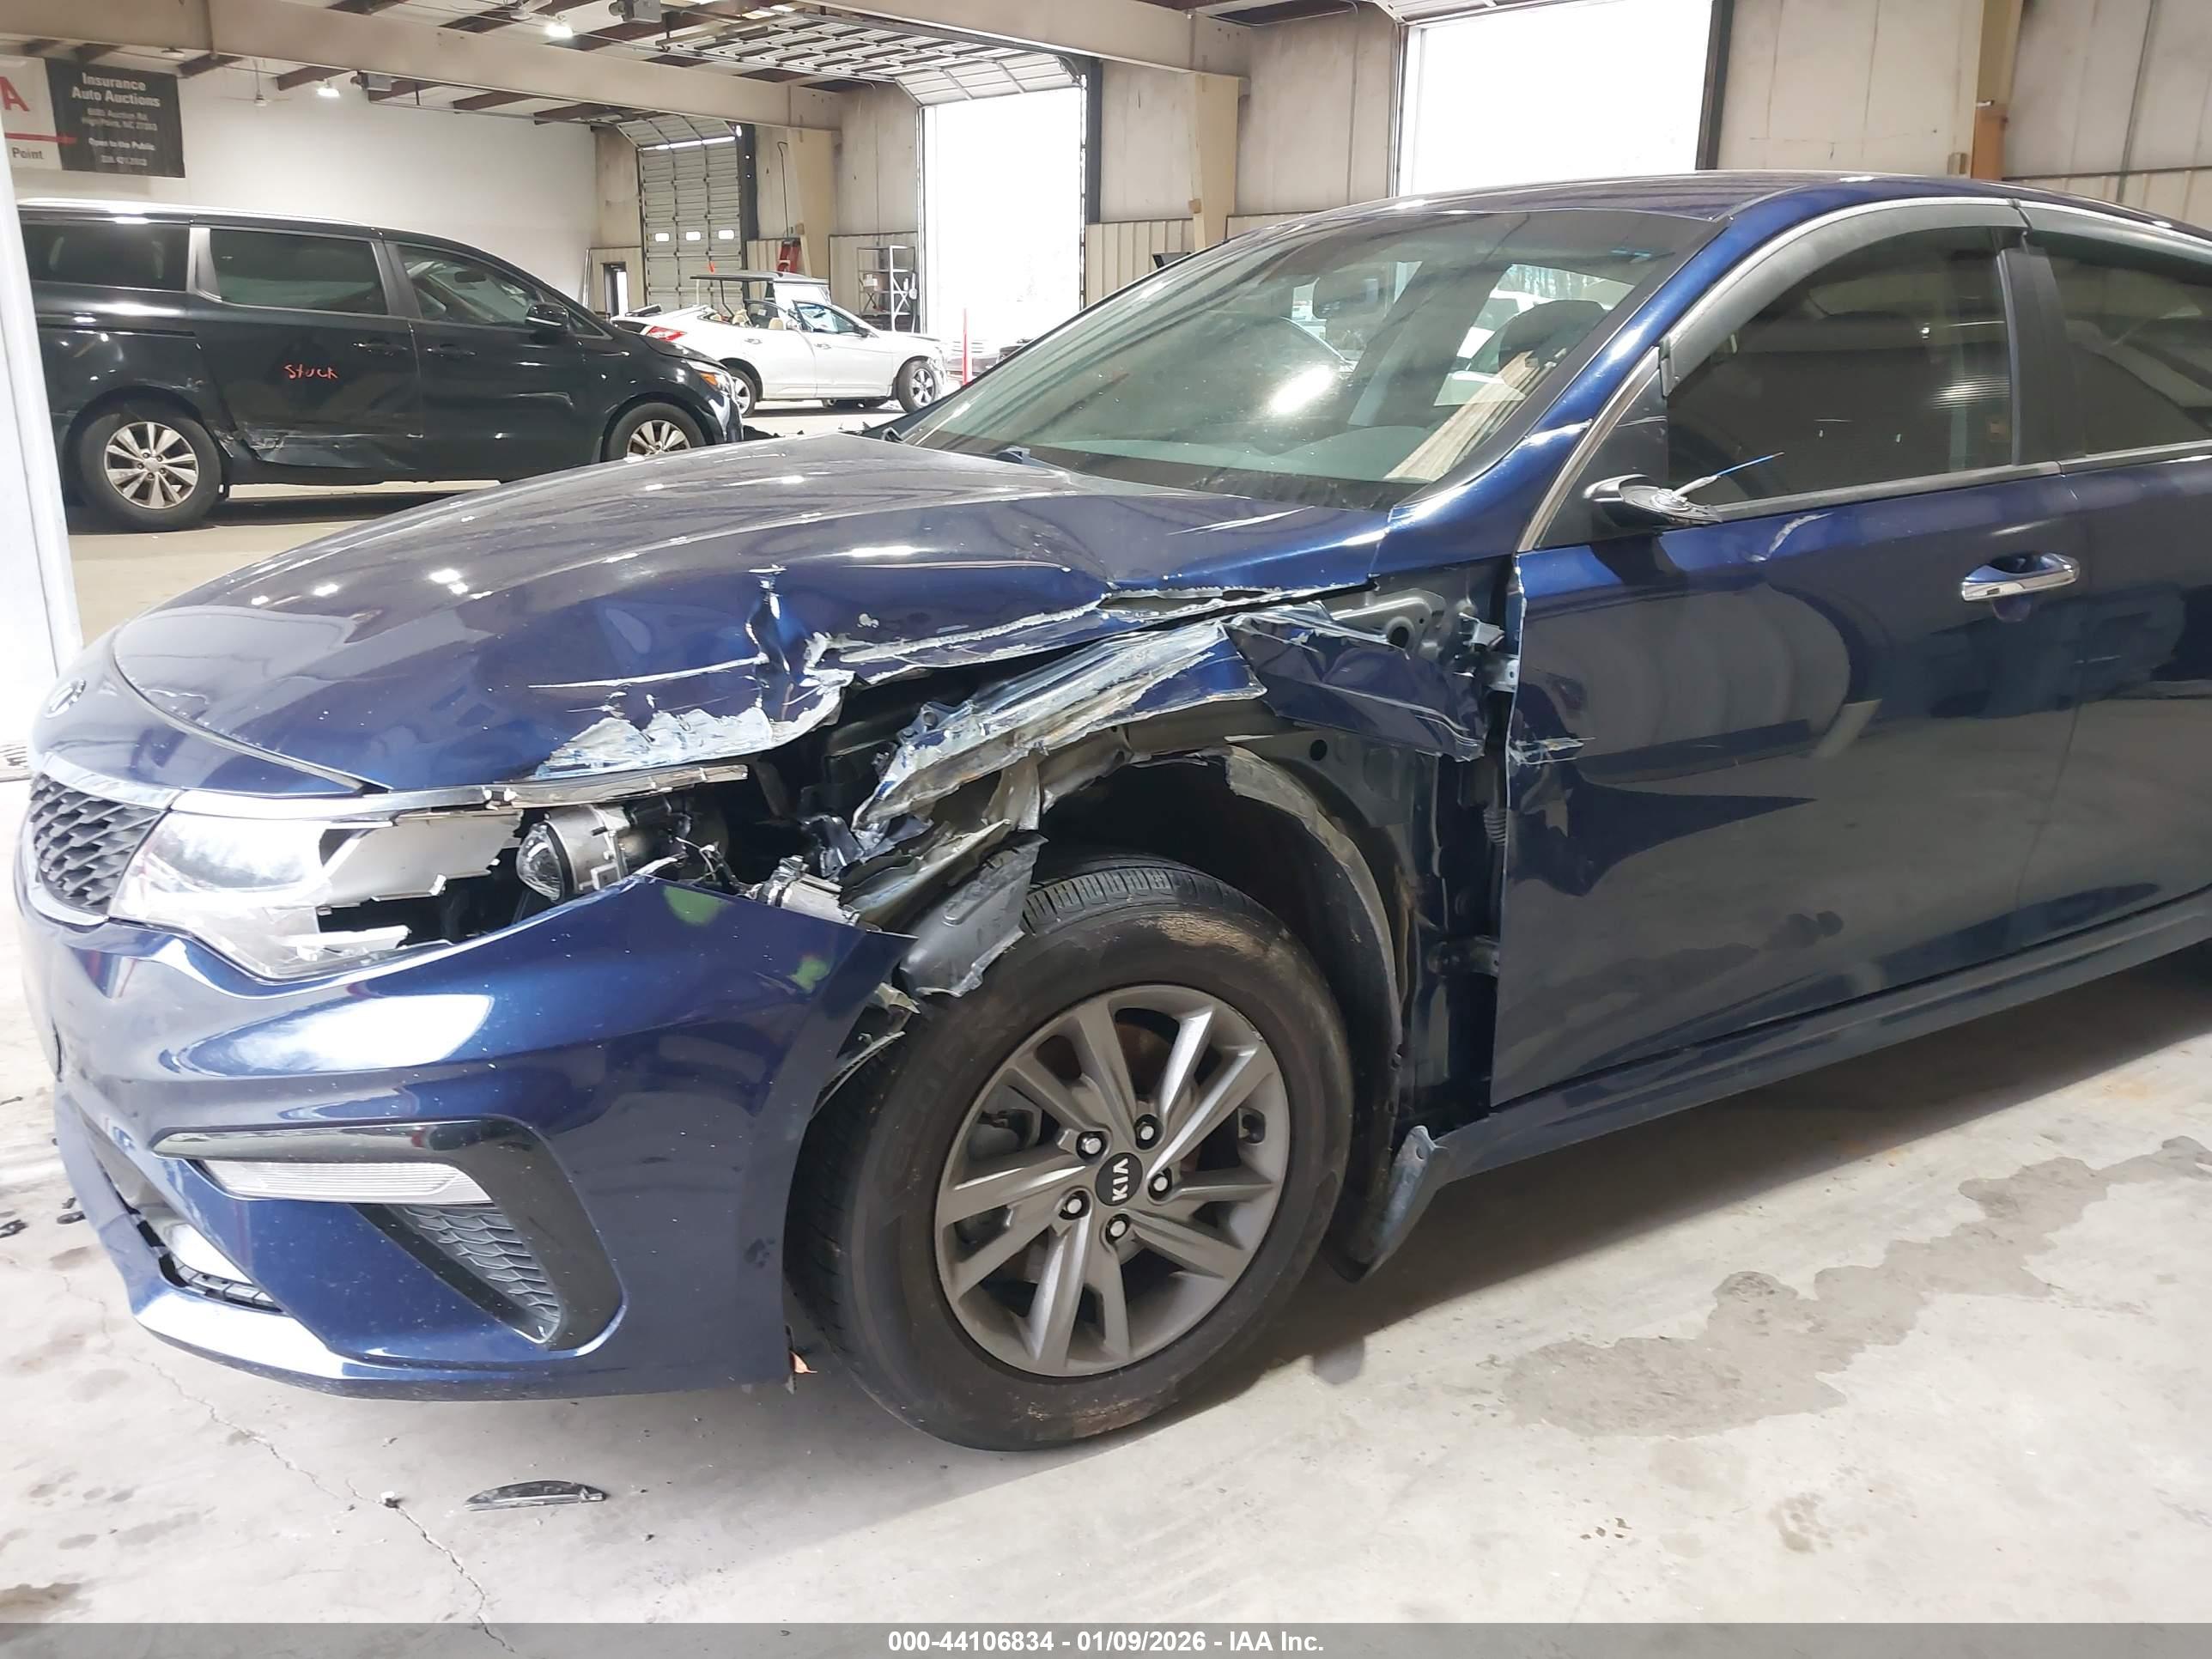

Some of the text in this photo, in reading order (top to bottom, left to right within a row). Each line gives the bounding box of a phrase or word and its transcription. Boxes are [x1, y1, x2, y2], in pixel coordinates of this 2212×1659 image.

[82, 72, 146, 91] Insurance
[71, 87, 161, 107] Auto Auctions
[12, 148, 45, 160] Point
[1112, 1158, 1129, 1201] KIA
